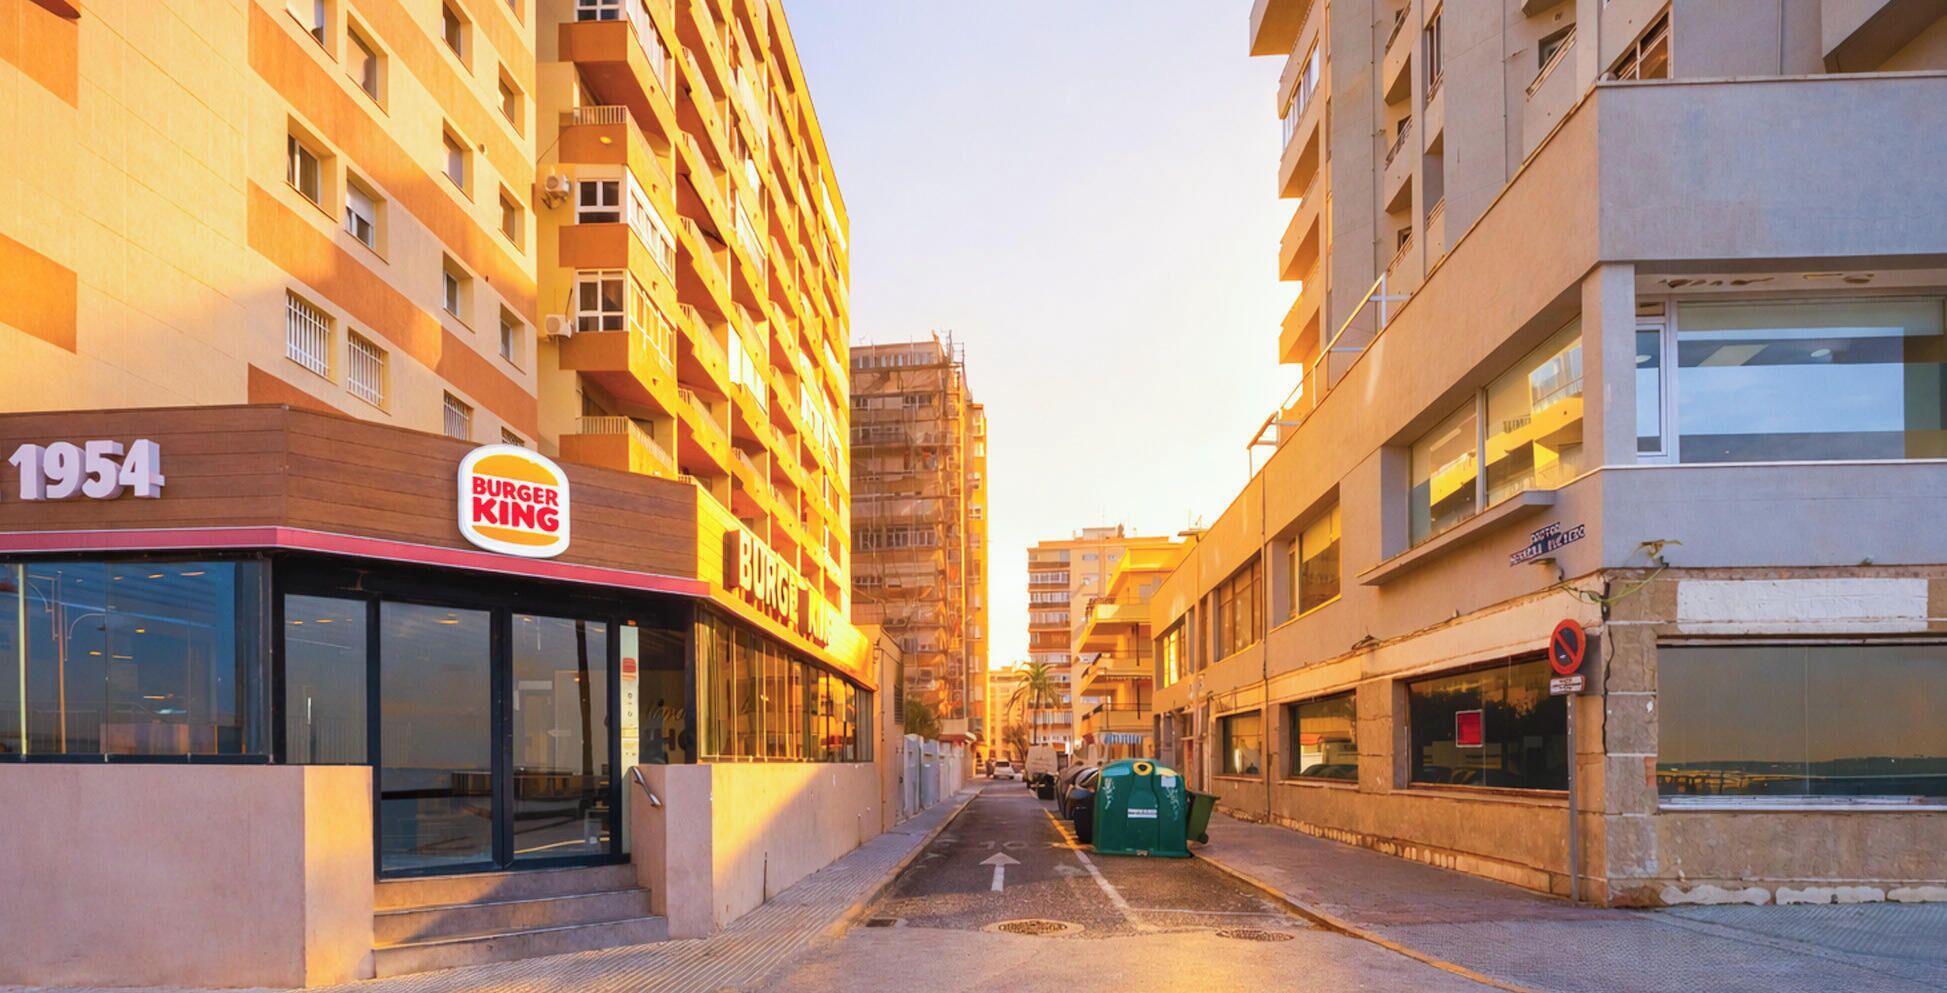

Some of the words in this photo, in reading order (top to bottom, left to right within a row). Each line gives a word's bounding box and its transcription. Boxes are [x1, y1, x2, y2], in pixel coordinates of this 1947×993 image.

[8, 439, 165, 500] 1954
[472, 476, 559, 507] BURGER
[473, 497, 560, 532] KING
[738, 528, 800, 625] BURGE
